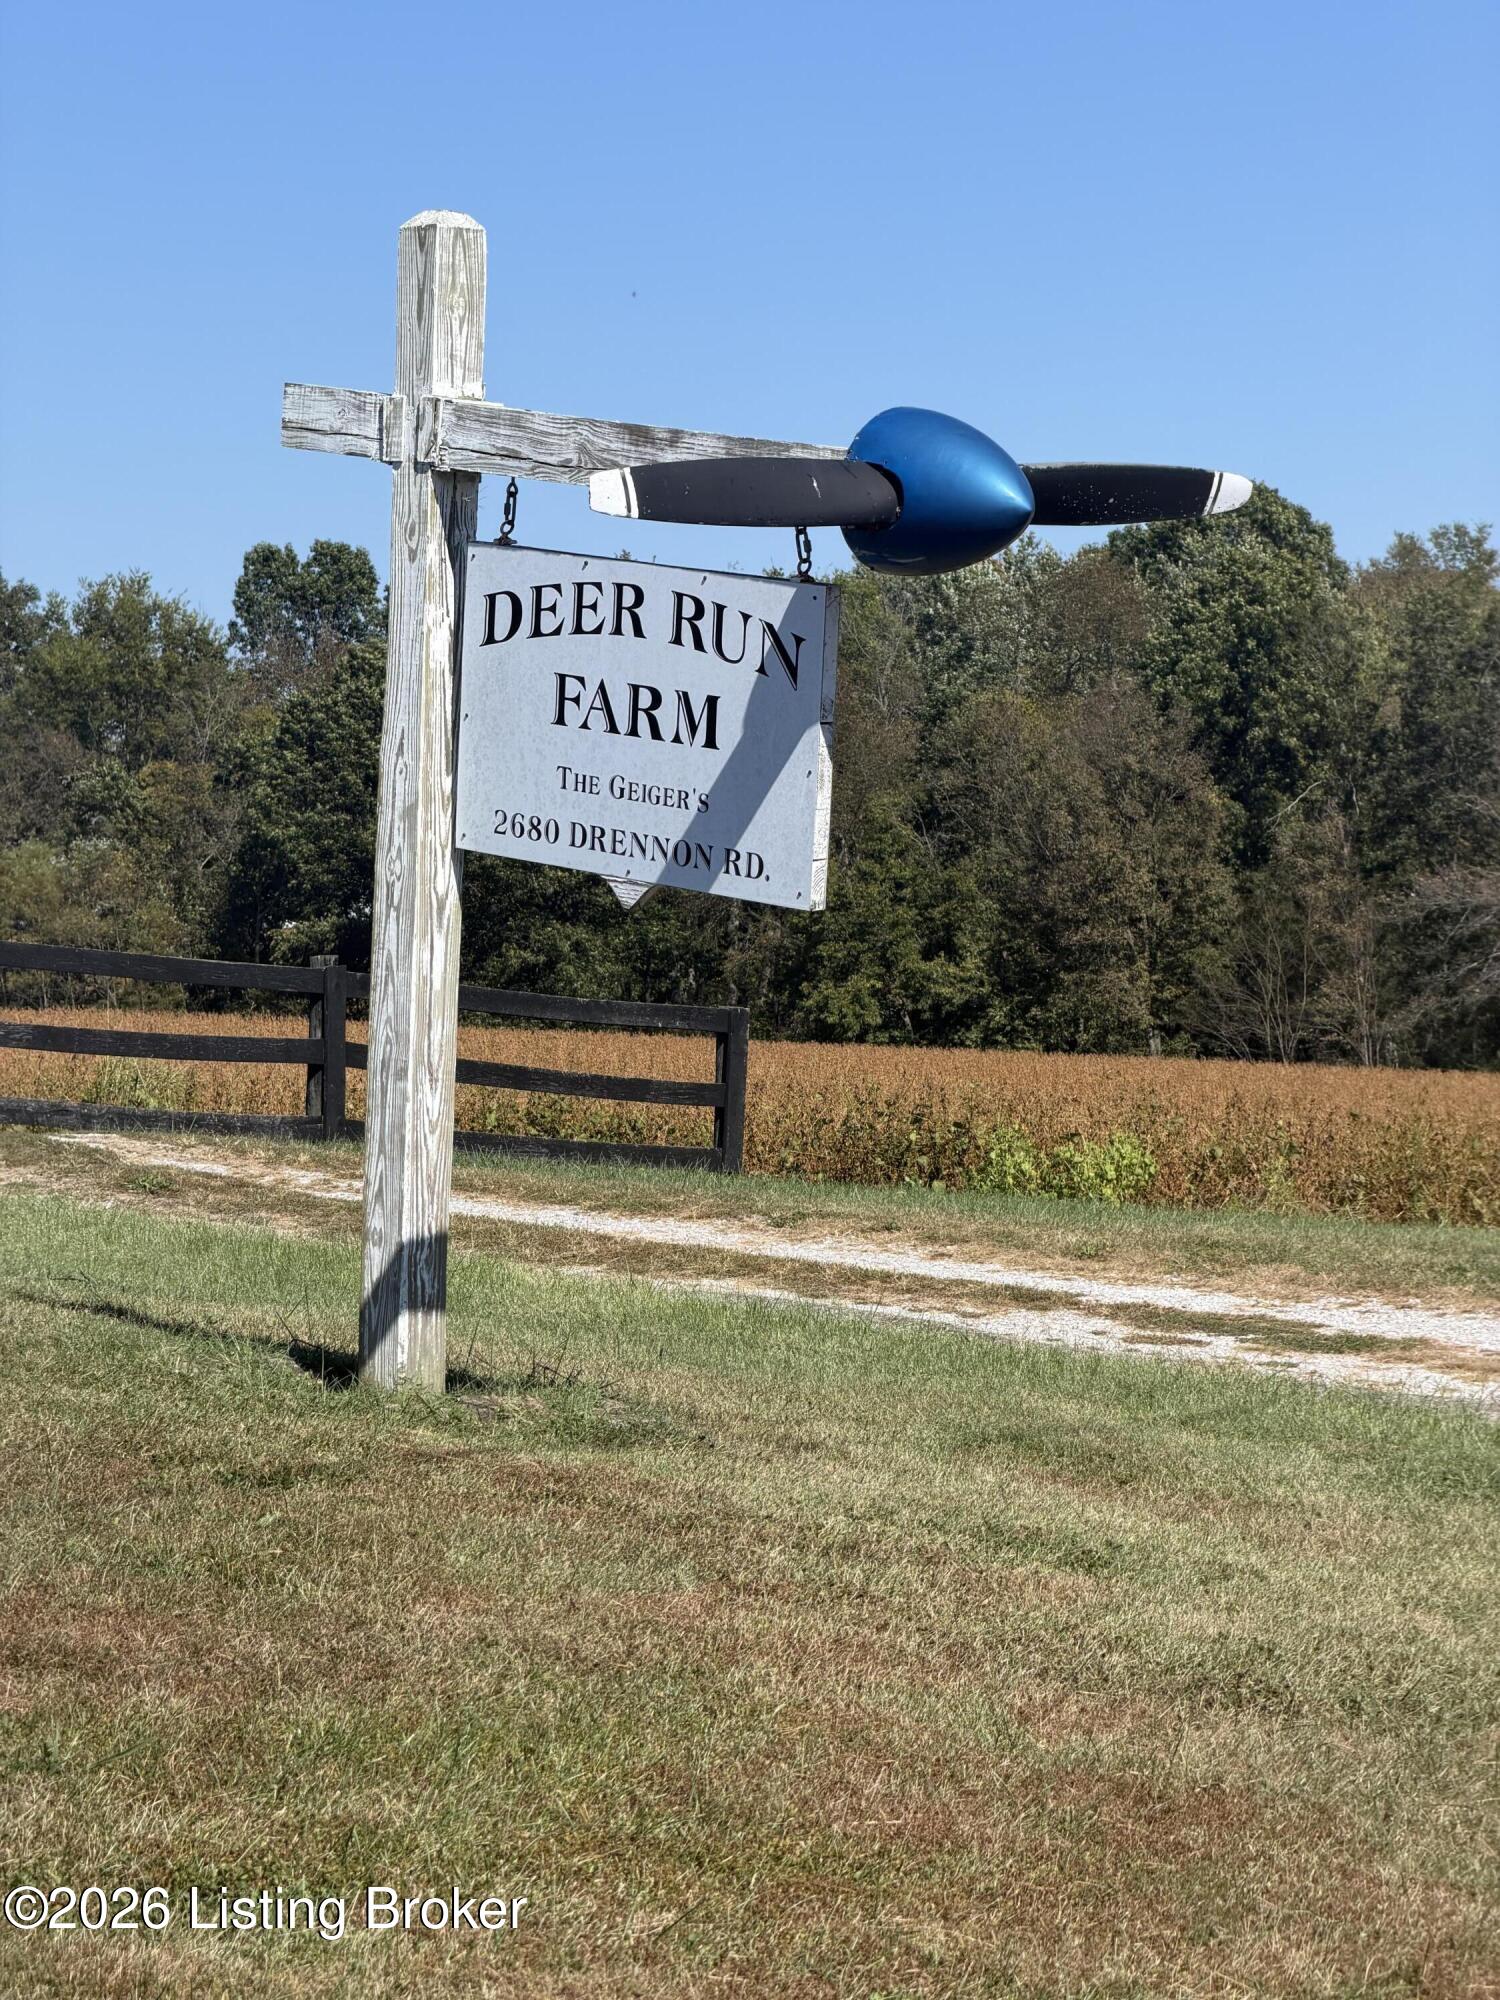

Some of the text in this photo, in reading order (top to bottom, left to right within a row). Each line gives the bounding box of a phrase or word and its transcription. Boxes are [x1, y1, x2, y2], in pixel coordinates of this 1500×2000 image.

[479, 581, 806, 691] DEER RUN
[550, 672, 721, 750] FARM
[493, 809, 770, 882] 2680 DRENNON RD.
